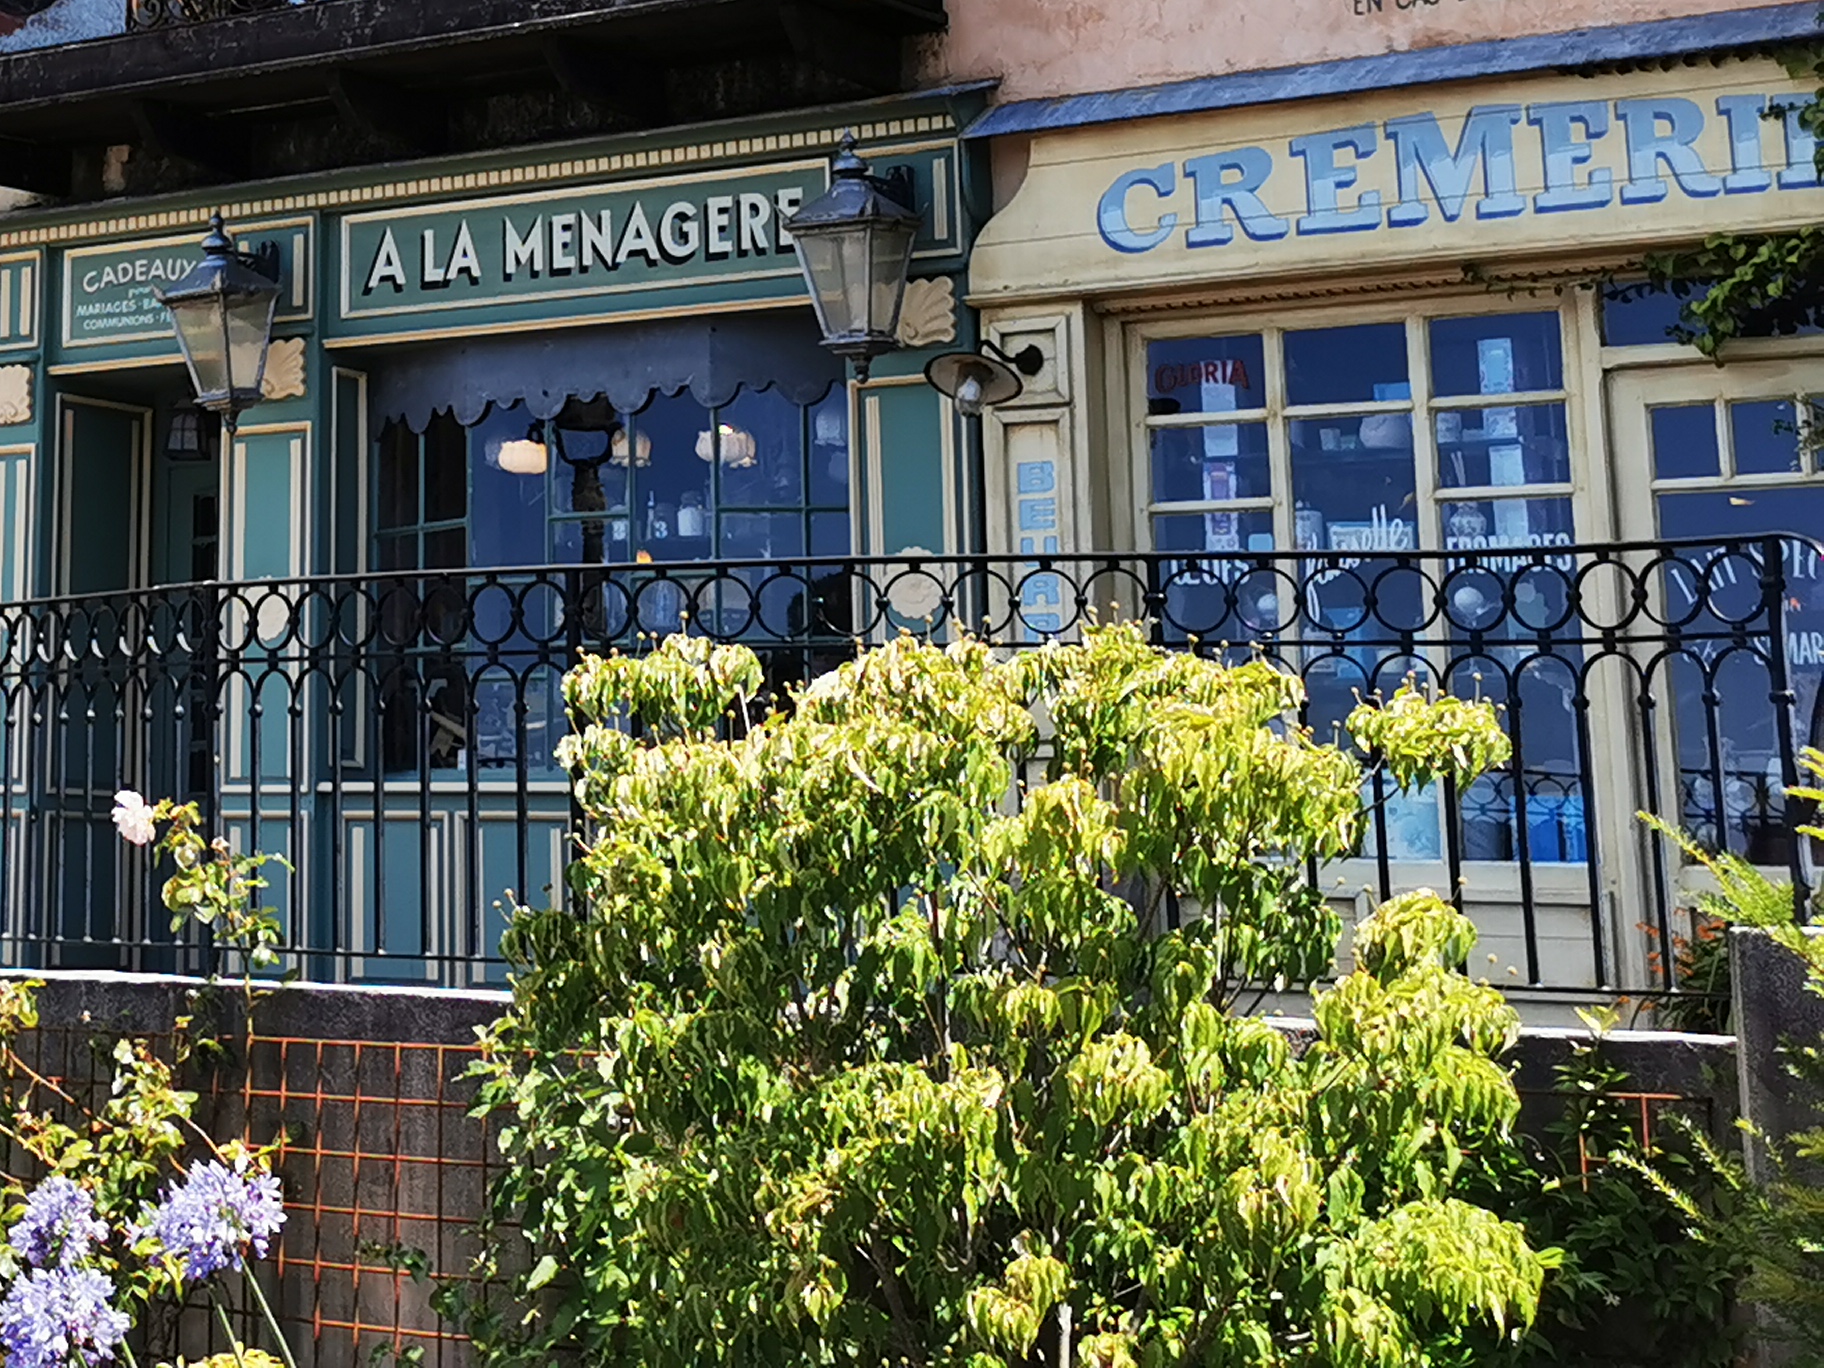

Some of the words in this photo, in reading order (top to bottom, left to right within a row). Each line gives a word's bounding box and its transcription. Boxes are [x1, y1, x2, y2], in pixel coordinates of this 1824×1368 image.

[363, 226, 407, 295] A
[420, 218, 482, 291] LA
[503, 186, 805, 280] MENAGERE
[76, 299, 137, 318] MARIAGES
[83, 314, 154, 331] COMMUNIONS
[1017, 460, 1060, 643] BEURR
